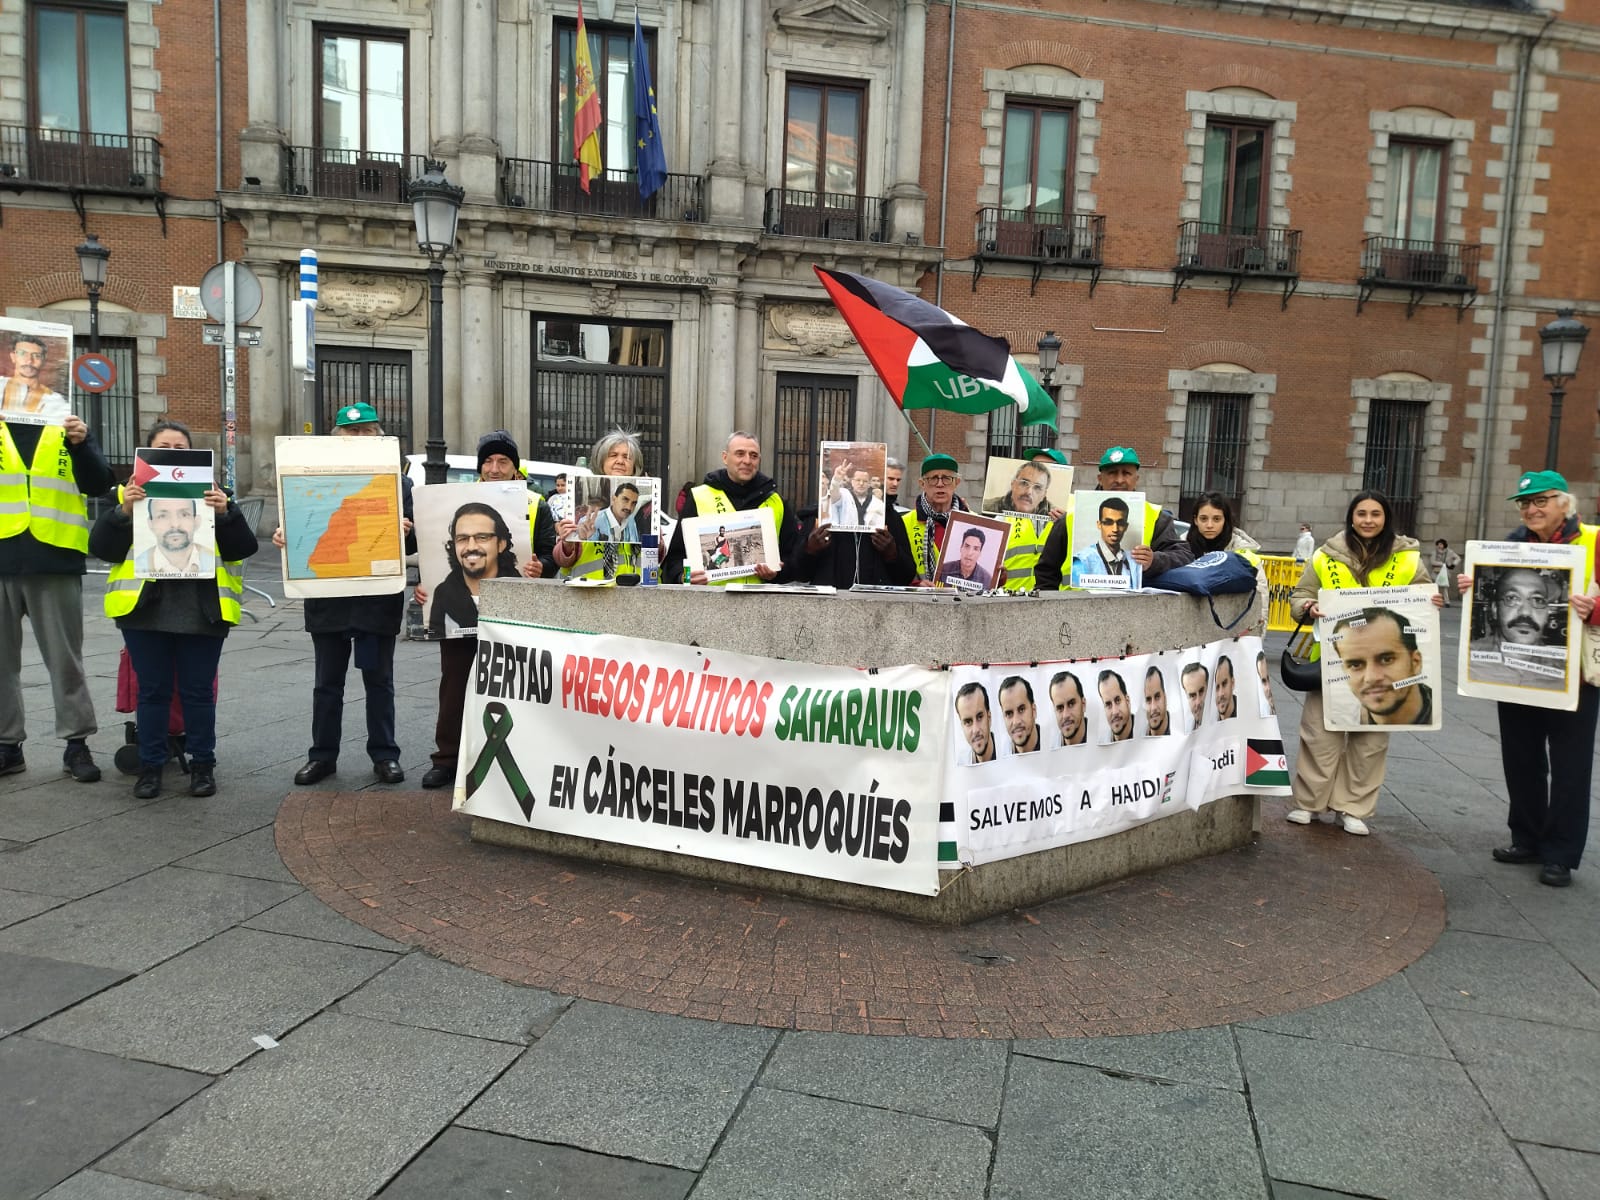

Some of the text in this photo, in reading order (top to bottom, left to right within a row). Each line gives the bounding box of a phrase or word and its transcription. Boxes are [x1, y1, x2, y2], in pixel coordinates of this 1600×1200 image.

[483, 259, 530, 272] MINISTERIO
[532, 264, 544, 273] DE
[548, 265, 585, 276] ASUNTOS
[587, 268, 638, 280] EXTERIORES
[650, 274, 661, 282] DE
[932, 374, 991, 399] LIB
[58, 431, 68, 477] IBRE
[1327, 558, 1342, 590] AHAR
[1382, 556, 1399, 588] LIBR
[475, 640, 923, 753] BERTAD PRESOS POLÍTICOS SAHARAUIS
[548, 744, 912, 864] EN CÁRCELES MARROQUÍES
[970, 777, 1161, 831] SALVEMOS A HADDI
